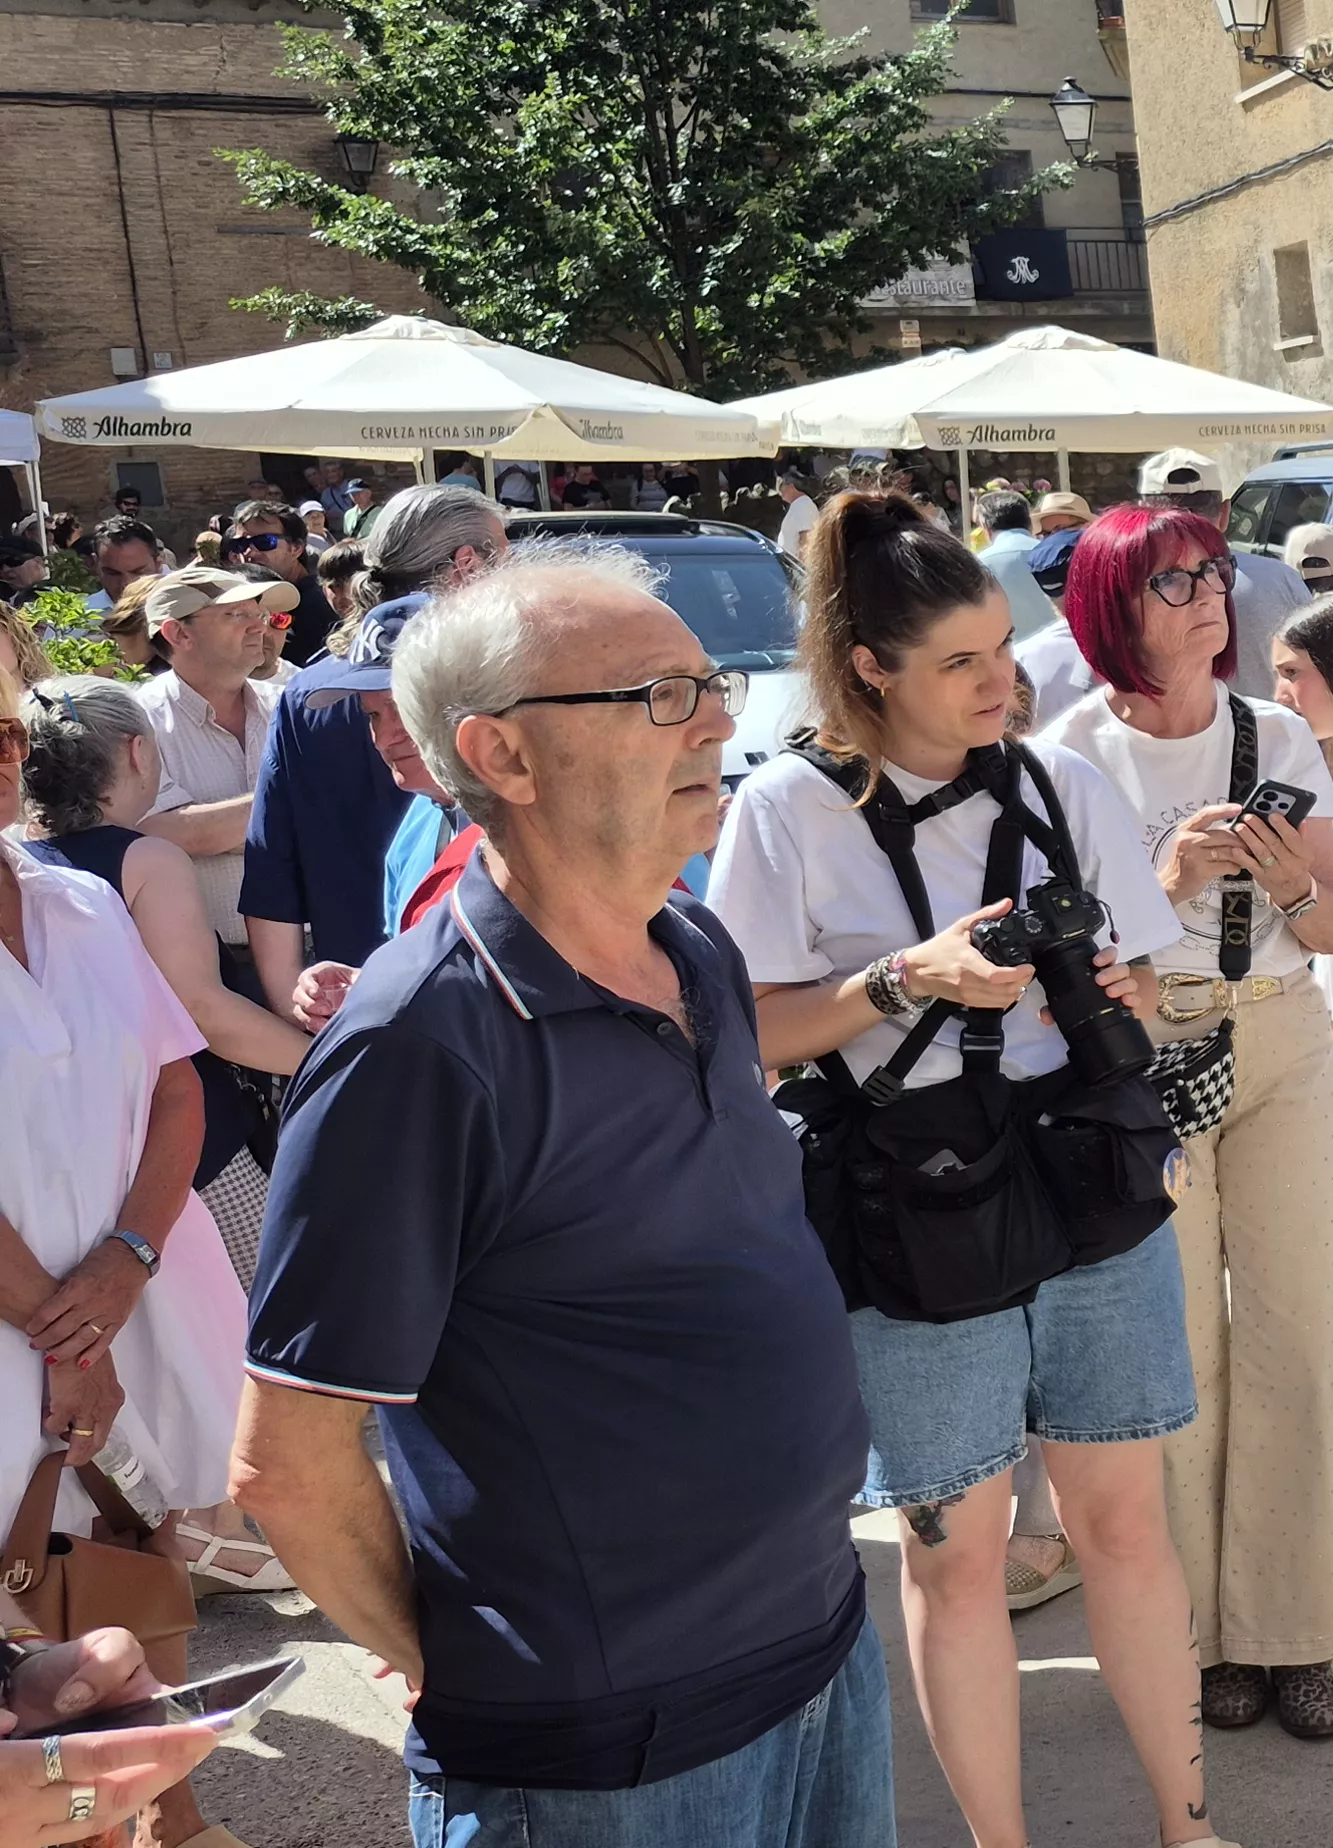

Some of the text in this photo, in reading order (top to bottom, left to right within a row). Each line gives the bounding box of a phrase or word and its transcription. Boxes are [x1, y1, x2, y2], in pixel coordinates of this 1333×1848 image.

[871, 278, 966, 296] estaurante
[93, 416, 192, 438] Alhambra
[361, 426, 415, 439] CERVEZA
[419, 426, 459, 439] HECHA
[464, 426, 485, 438] SIN
[966, 424, 1055, 444] Alhambra
[1199, 423, 1326, 437] CERVEZA HECHA SIN PRISA
